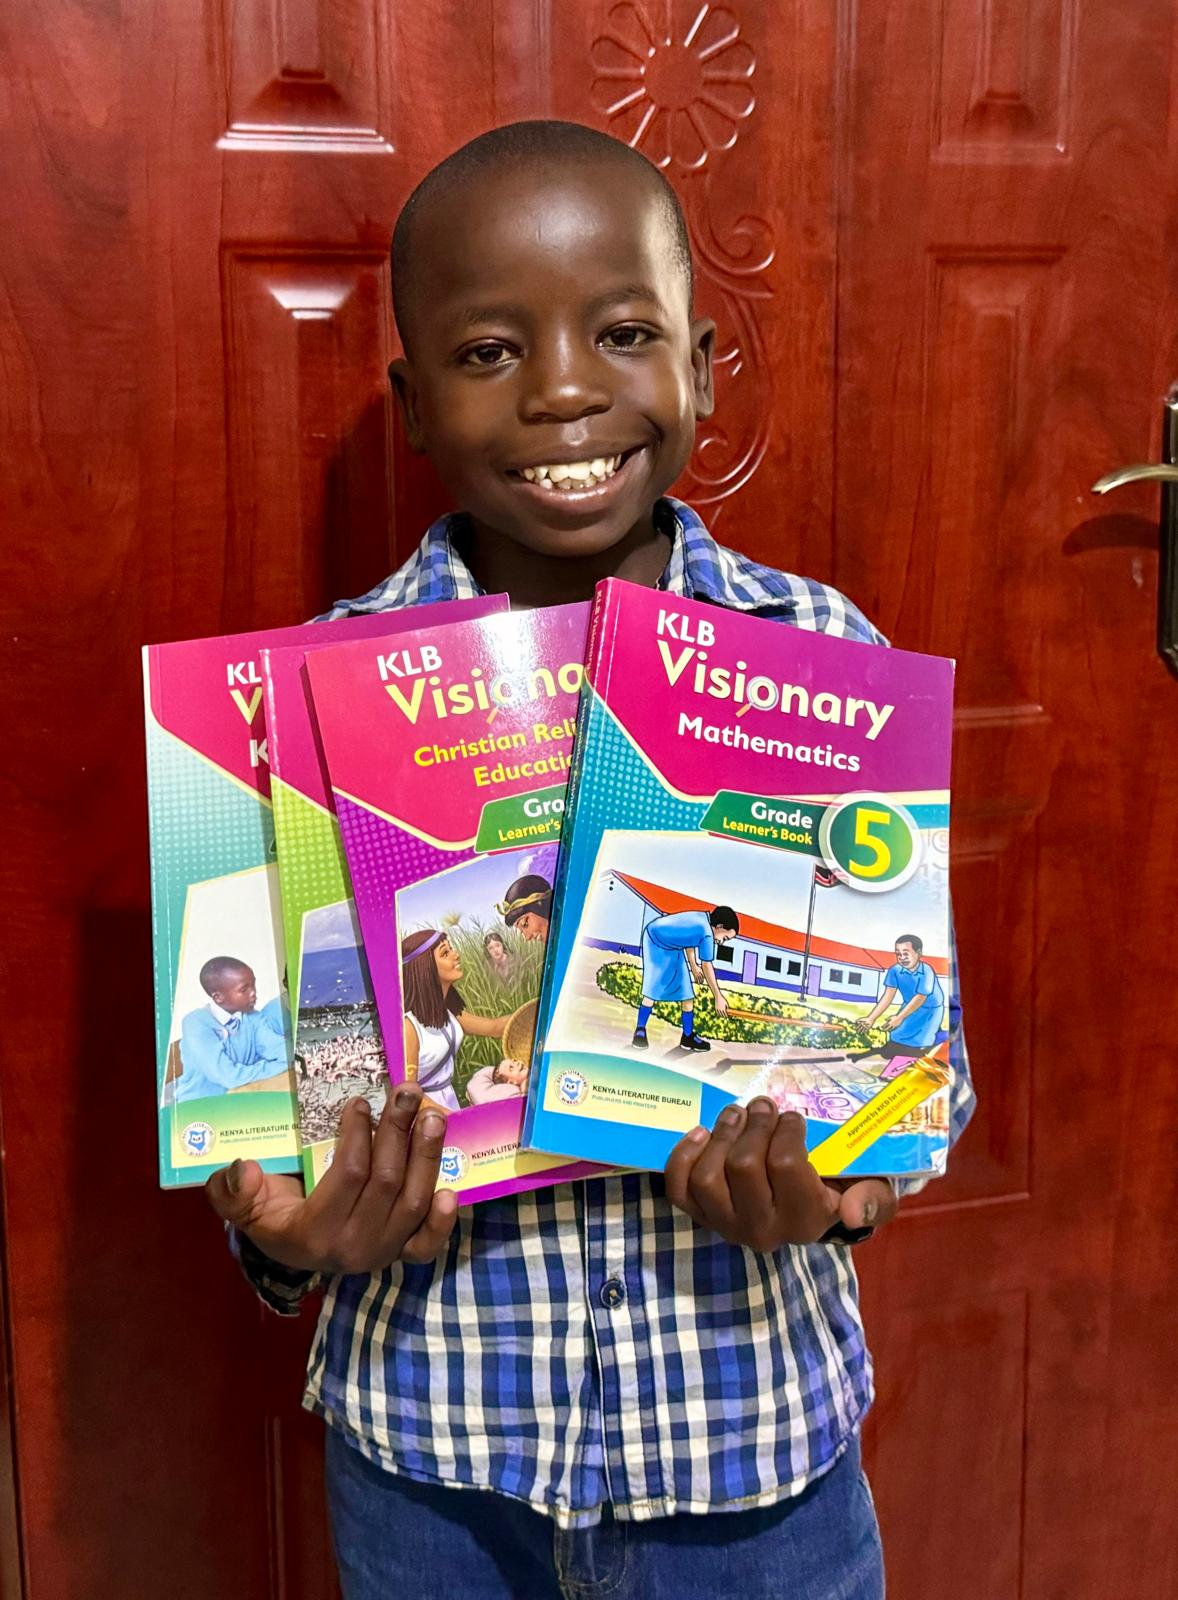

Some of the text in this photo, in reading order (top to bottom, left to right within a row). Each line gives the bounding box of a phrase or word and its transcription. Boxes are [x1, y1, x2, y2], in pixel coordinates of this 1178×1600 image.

[656, 609, 716, 647] KLB
[226, 661, 262, 686] KL
[376, 645, 443, 681] KLB
[656, 639, 896, 741] Visionary
[229, 686, 263, 726] V
[249, 738, 269, 767] K
[414, 731, 526, 767] Christian
[677, 712, 861, 772] Mathematics
[498, 818, 561, 842] Learner's
[750, 801, 813, 829] Grade
[722, 816, 813, 846] Learner's Book
[848, 807, 891, 878] 5
[592, 1085, 692, 1107] KENYA LITERATURE BUREAU
[219, 1128, 244, 1137] KENYA
[245, 1125, 290, 1135] LITERATURE
[471, 1147, 496, 1160] KENYA
